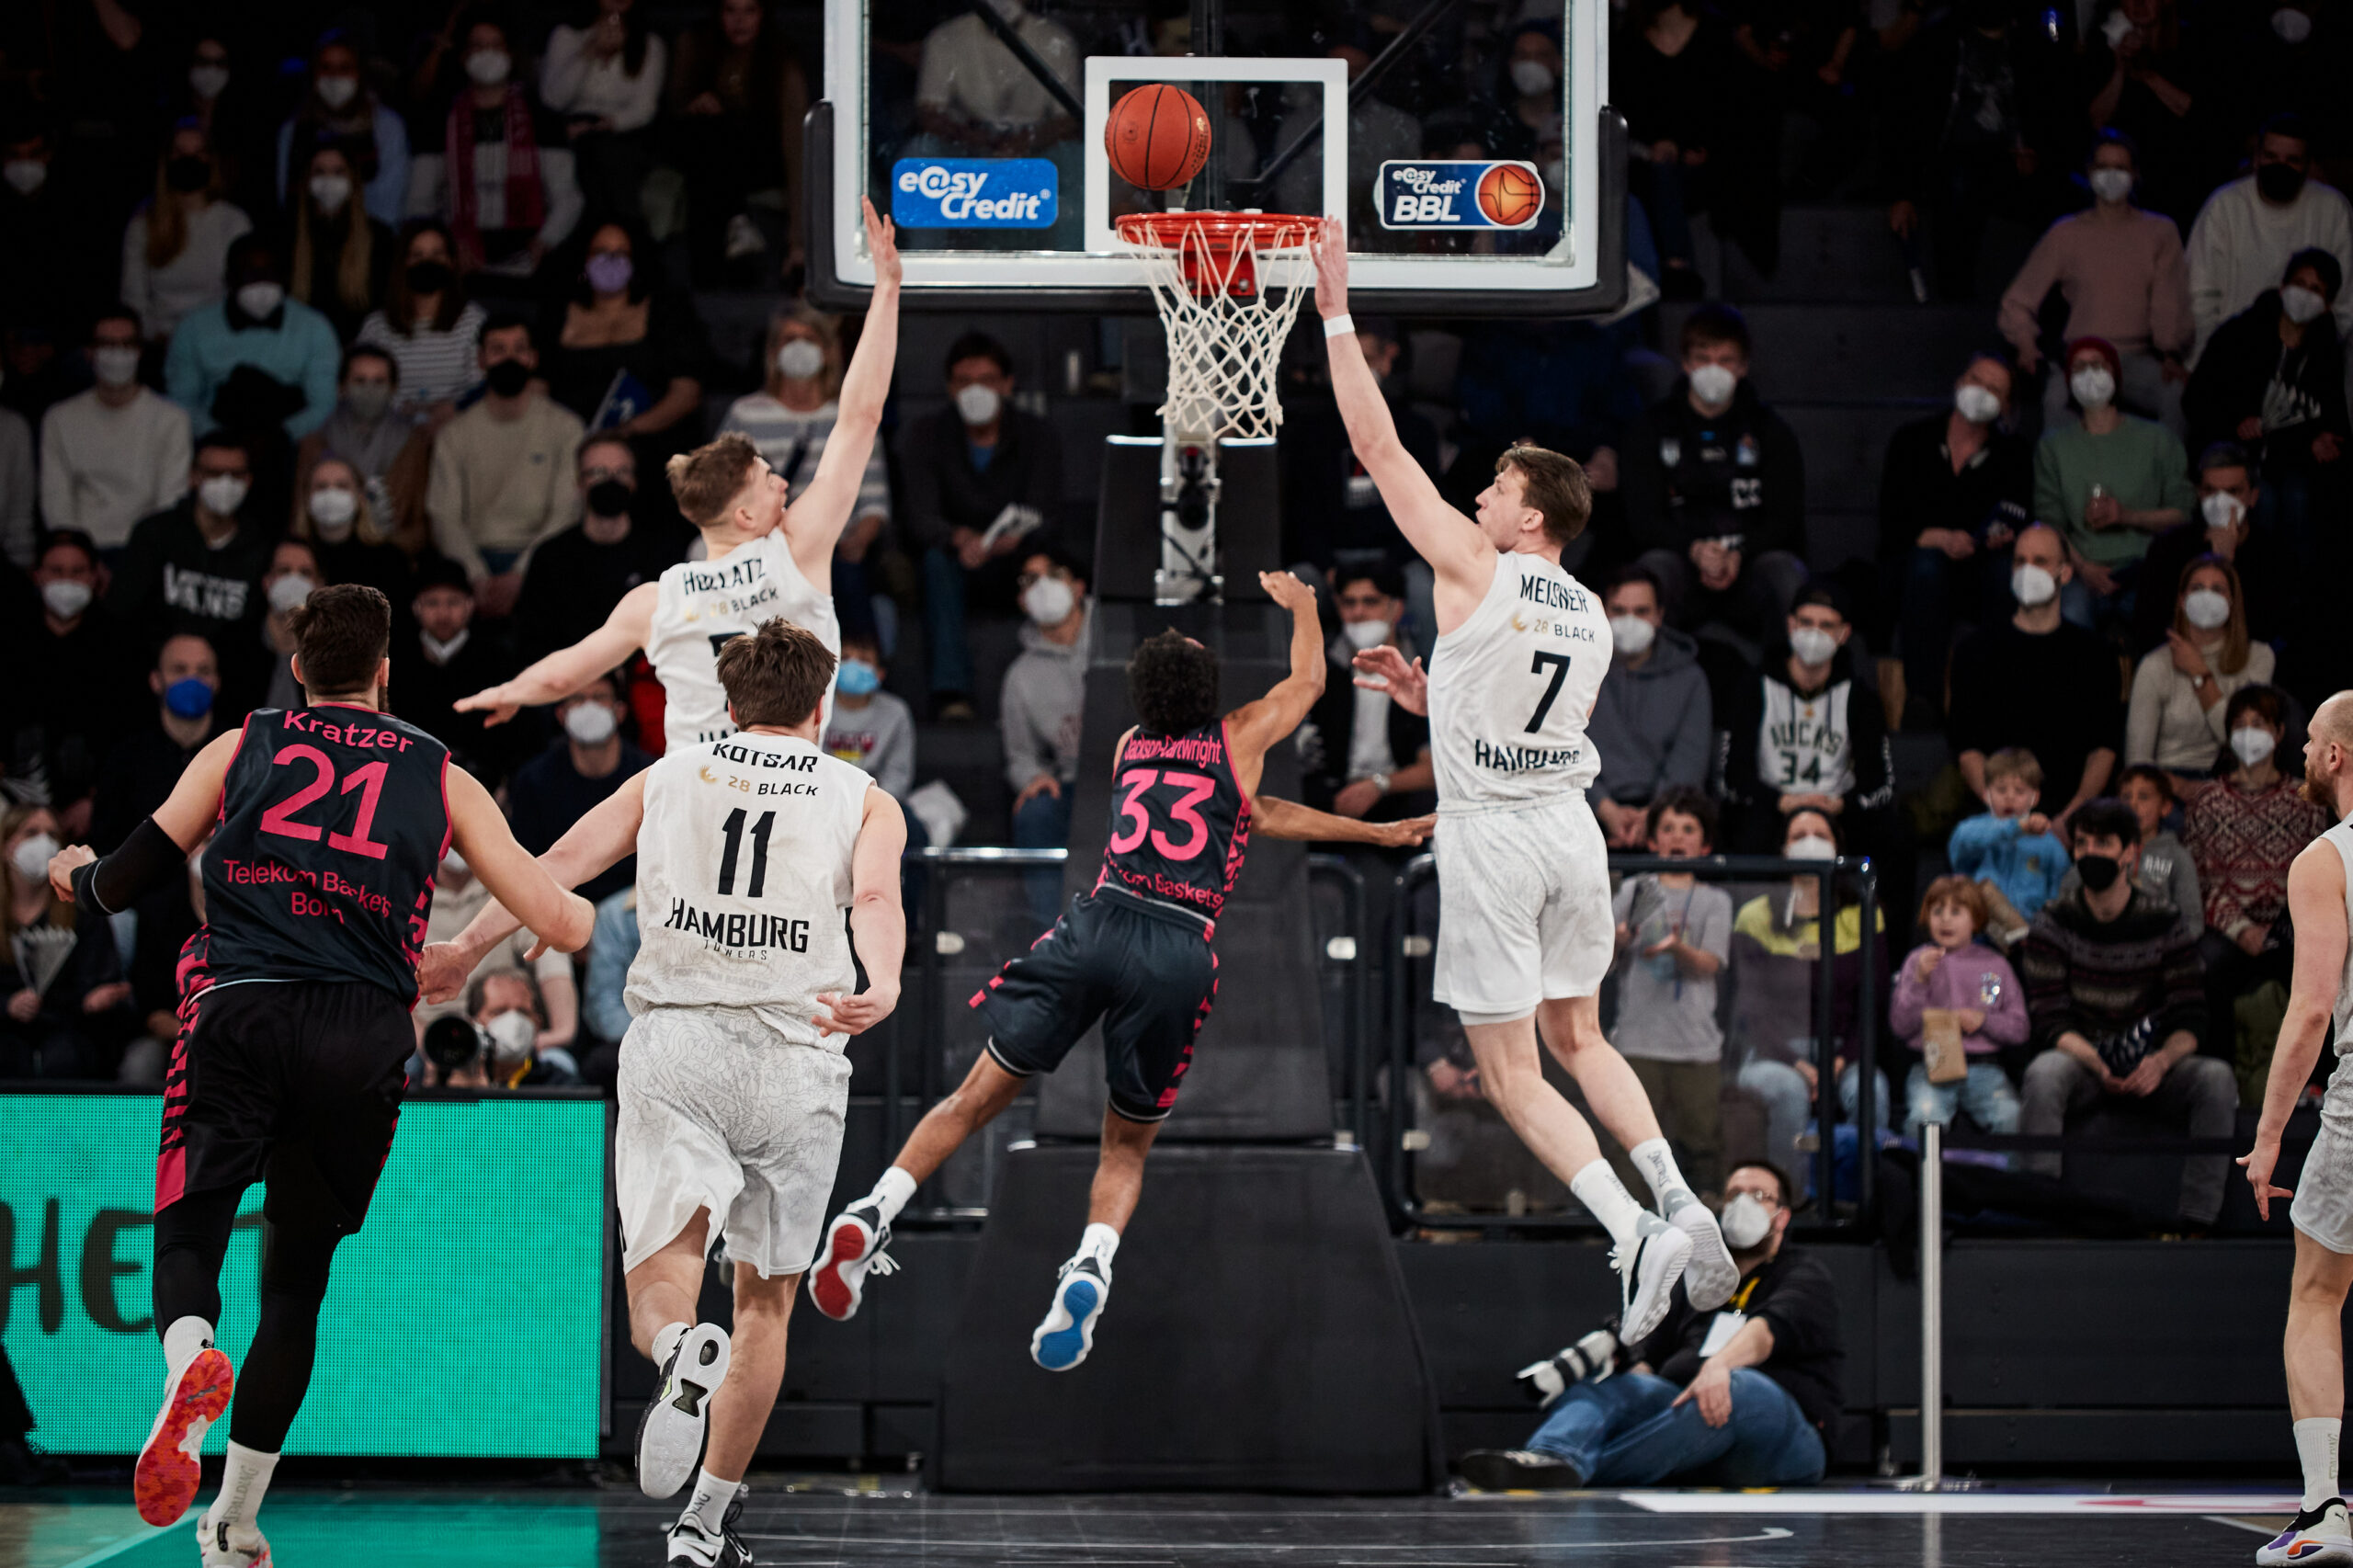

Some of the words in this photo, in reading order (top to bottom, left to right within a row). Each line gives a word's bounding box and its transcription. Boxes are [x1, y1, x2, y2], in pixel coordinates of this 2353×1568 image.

[1392, 195, 1461, 222] BBL
[731, 587, 779, 613] BLACK
[1519, 573, 1589, 614] MEISNER
[1533, 618, 1550, 636] 28
[1554, 623, 1596, 643] BLACK
[1523, 649, 1572, 734] 7
[283, 710, 415, 754] Kratzer
[711, 743, 819, 773] KOTSAR
[1779, 749, 1822, 786] 34
[259, 743, 390, 861] 21
[727, 775, 751, 793] 28
[757, 782, 819, 797] BLACK
[1109, 768, 1217, 861] 33
[717, 807, 777, 898] 11
[1154, 872, 1224, 909] Baskets
[664, 896, 810, 954] HAMBURG
